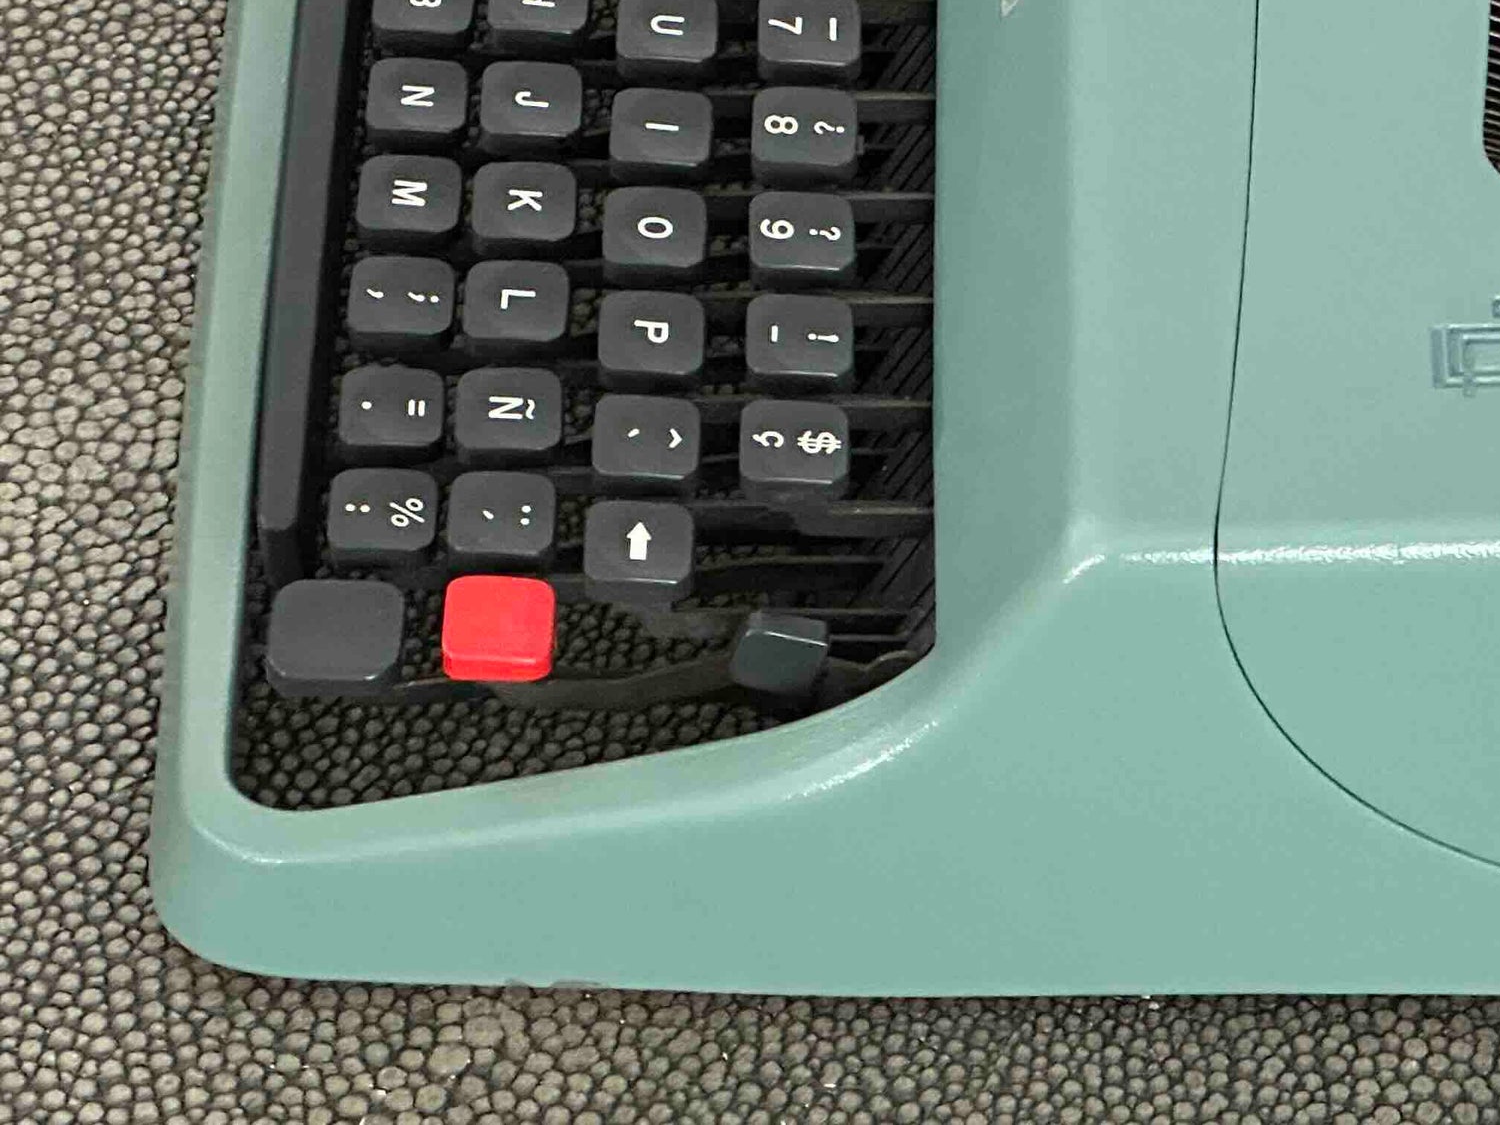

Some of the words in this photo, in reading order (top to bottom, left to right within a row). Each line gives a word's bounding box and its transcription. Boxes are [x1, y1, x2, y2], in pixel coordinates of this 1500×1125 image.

[650, 15, 685, 36] U
[767, 16, 803, 35] 7
[400, 85, 435, 107] N
[514, 91, 550, 108] J
[764, 114, 799, 135] 8
[391, 179, 428, 207] M
[507, 189, 543, 212] K
[637, 216, 674, 239] O
[759, 218, 795, 240] 9
[500, 289, 536, 310] L
[633, 319, 669, 344] P
[488, 396, 536, 420] Ñ
[797, 430, 842, 455] $
[389, 498, 425, 527] %
